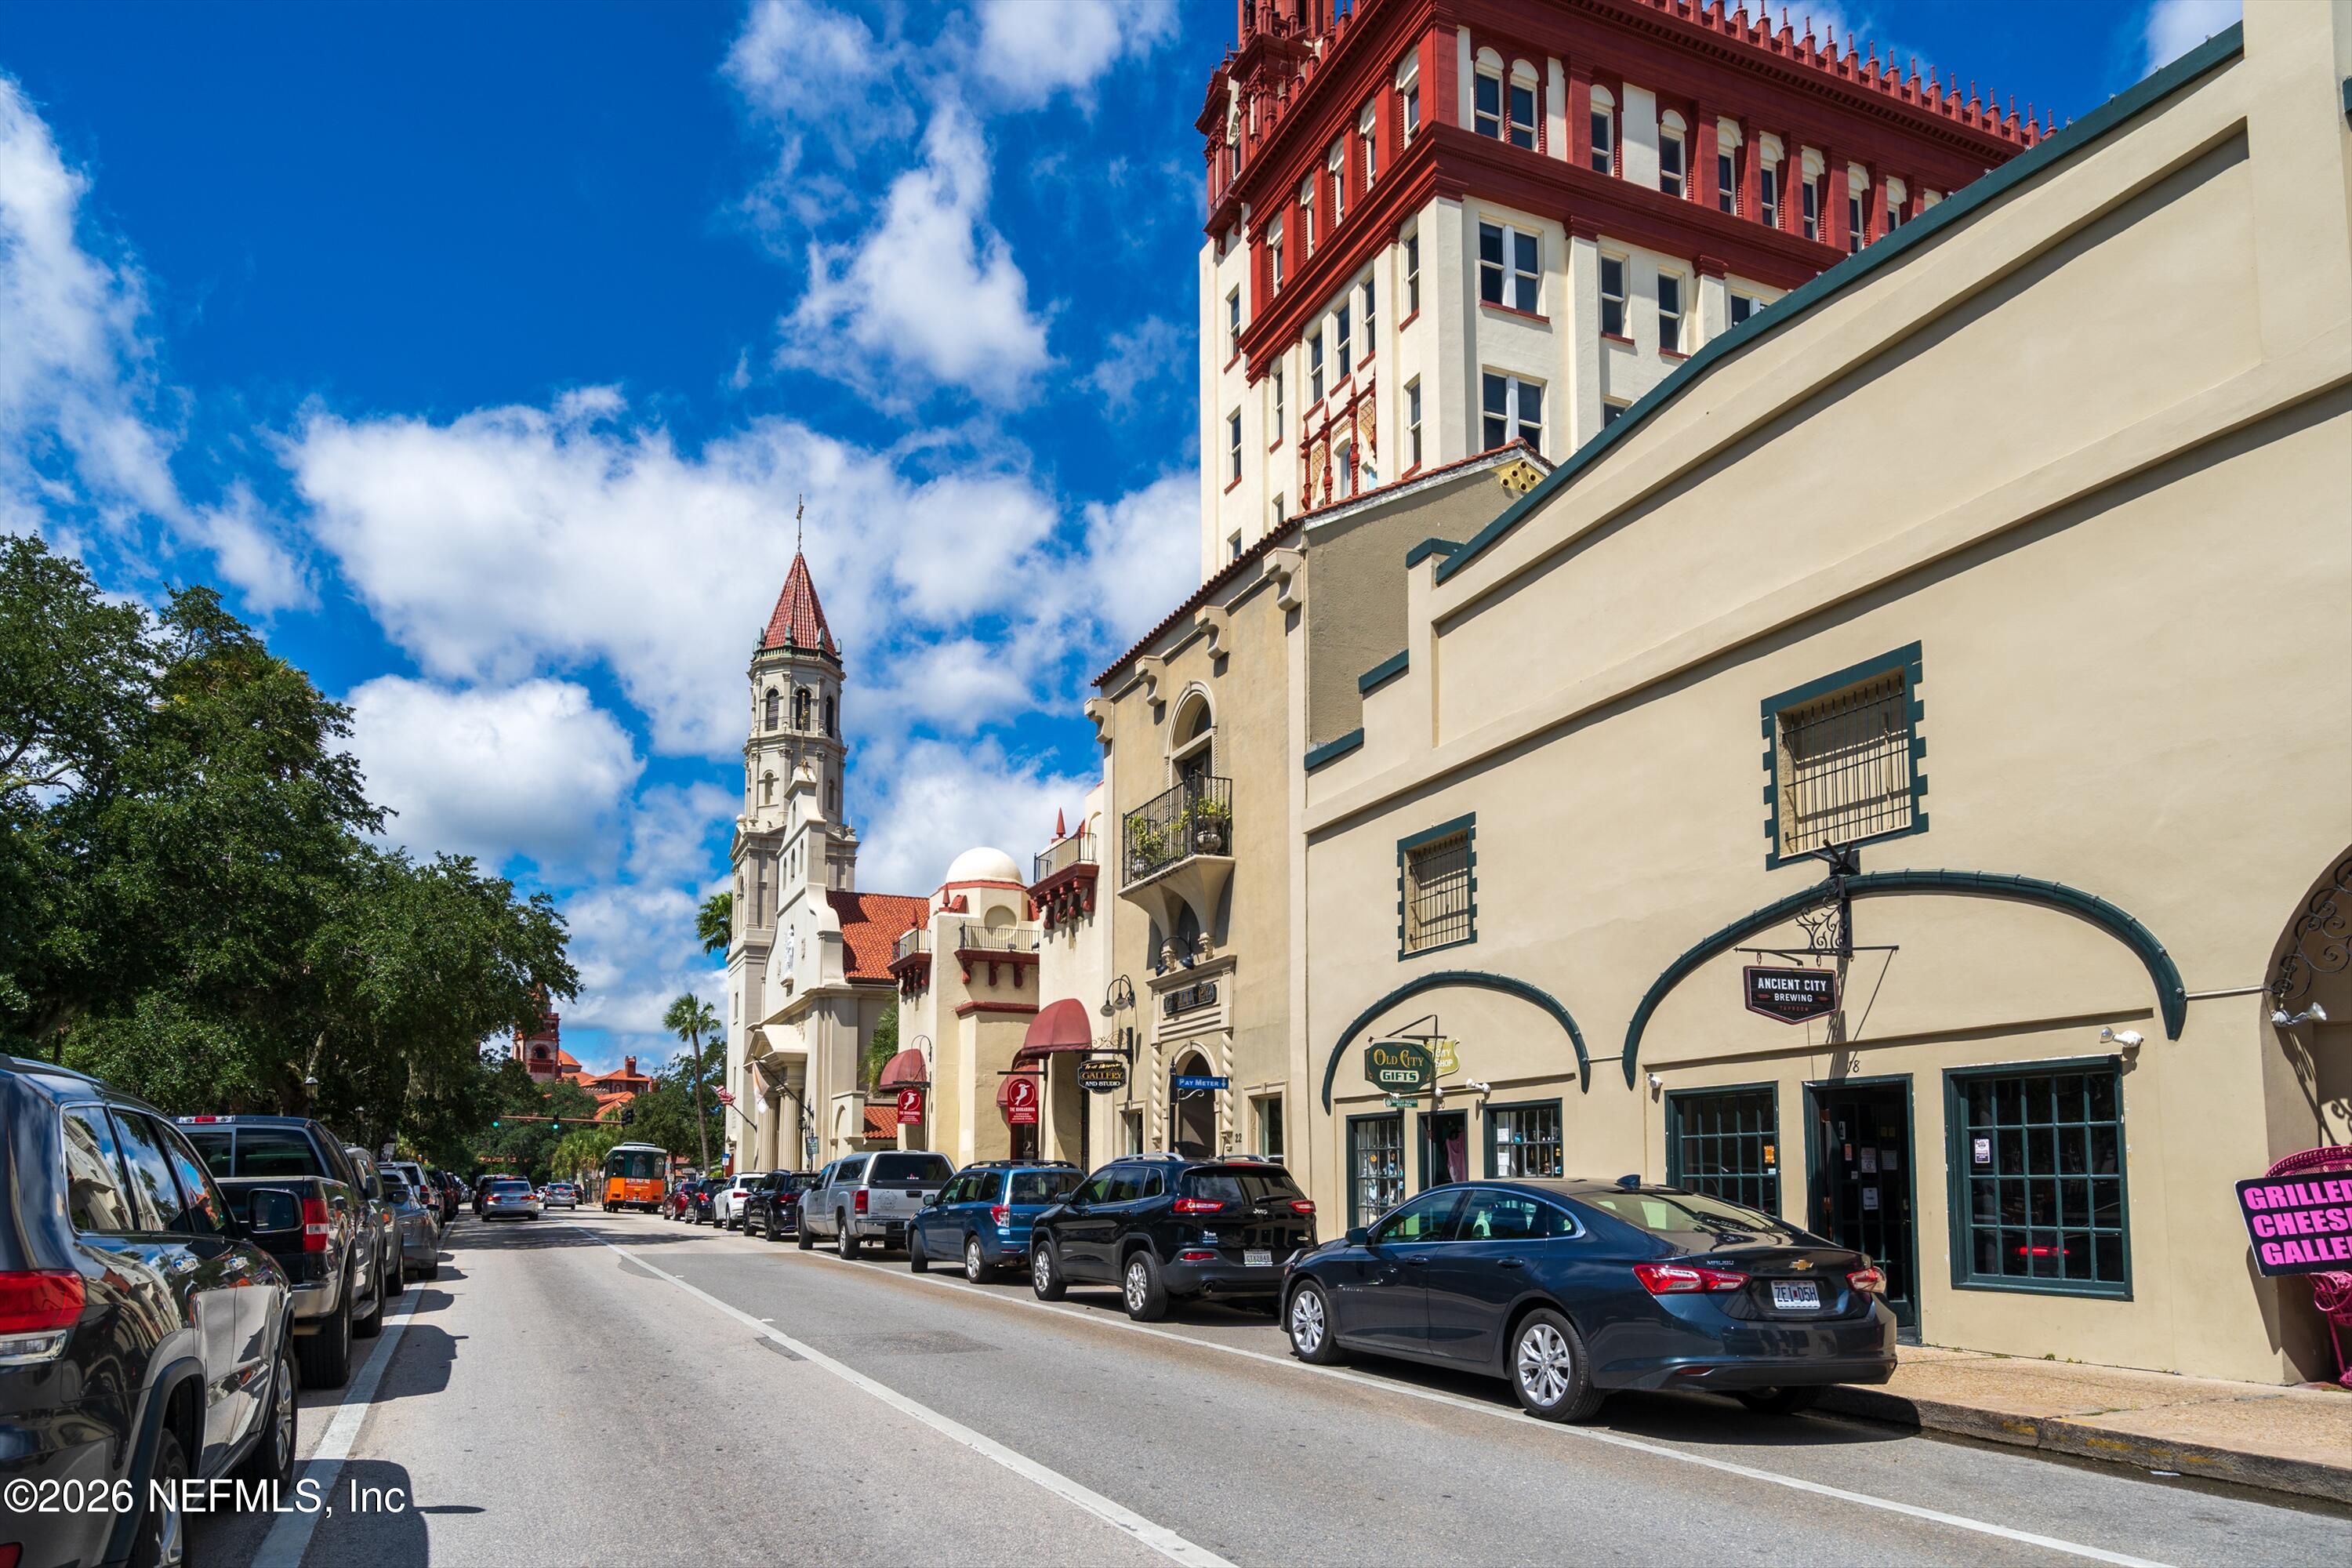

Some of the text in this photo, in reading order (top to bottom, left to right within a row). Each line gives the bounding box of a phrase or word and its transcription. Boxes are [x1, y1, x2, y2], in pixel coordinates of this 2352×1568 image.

[1758, 978, 1827, 992] ANCIENT CITY
[1774, 993, 1813, 1002] BREWING
[1374, 1048, 1425, 1069] OLD CITY
[1382, 1071, 1417, 1081] GIFTS
[1235, 1132, 1242, 1143] 22
